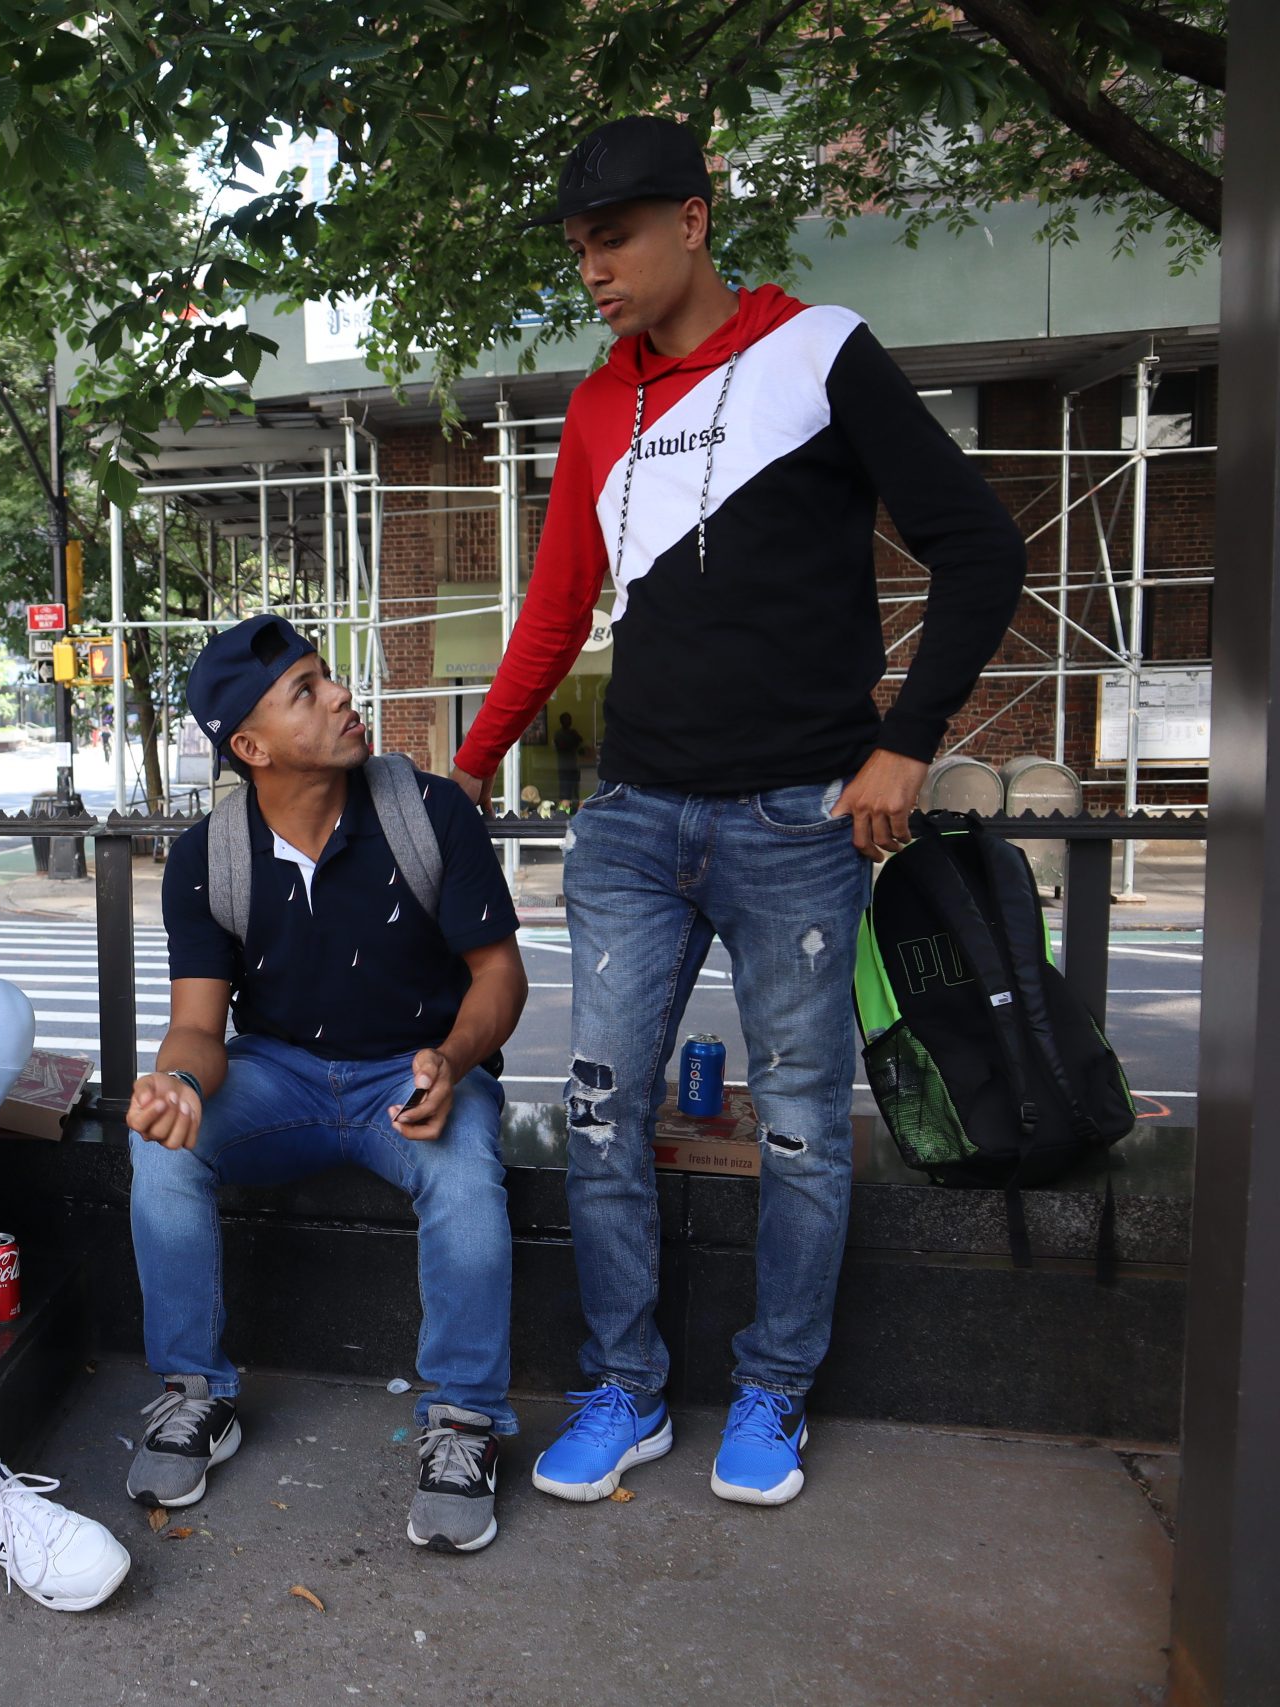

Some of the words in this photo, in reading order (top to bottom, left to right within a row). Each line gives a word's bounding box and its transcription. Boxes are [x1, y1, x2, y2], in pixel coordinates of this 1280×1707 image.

[446, 663, 498, 672] DAYCAR
[897, 933, 976, 994] PU
[689, 1057, 703, 1101] pepsi
[688, 1153, 711, 1165] fresh
[714, 1155, 728, 1167] hot
[730, 1157, 753, 1169] pizza
